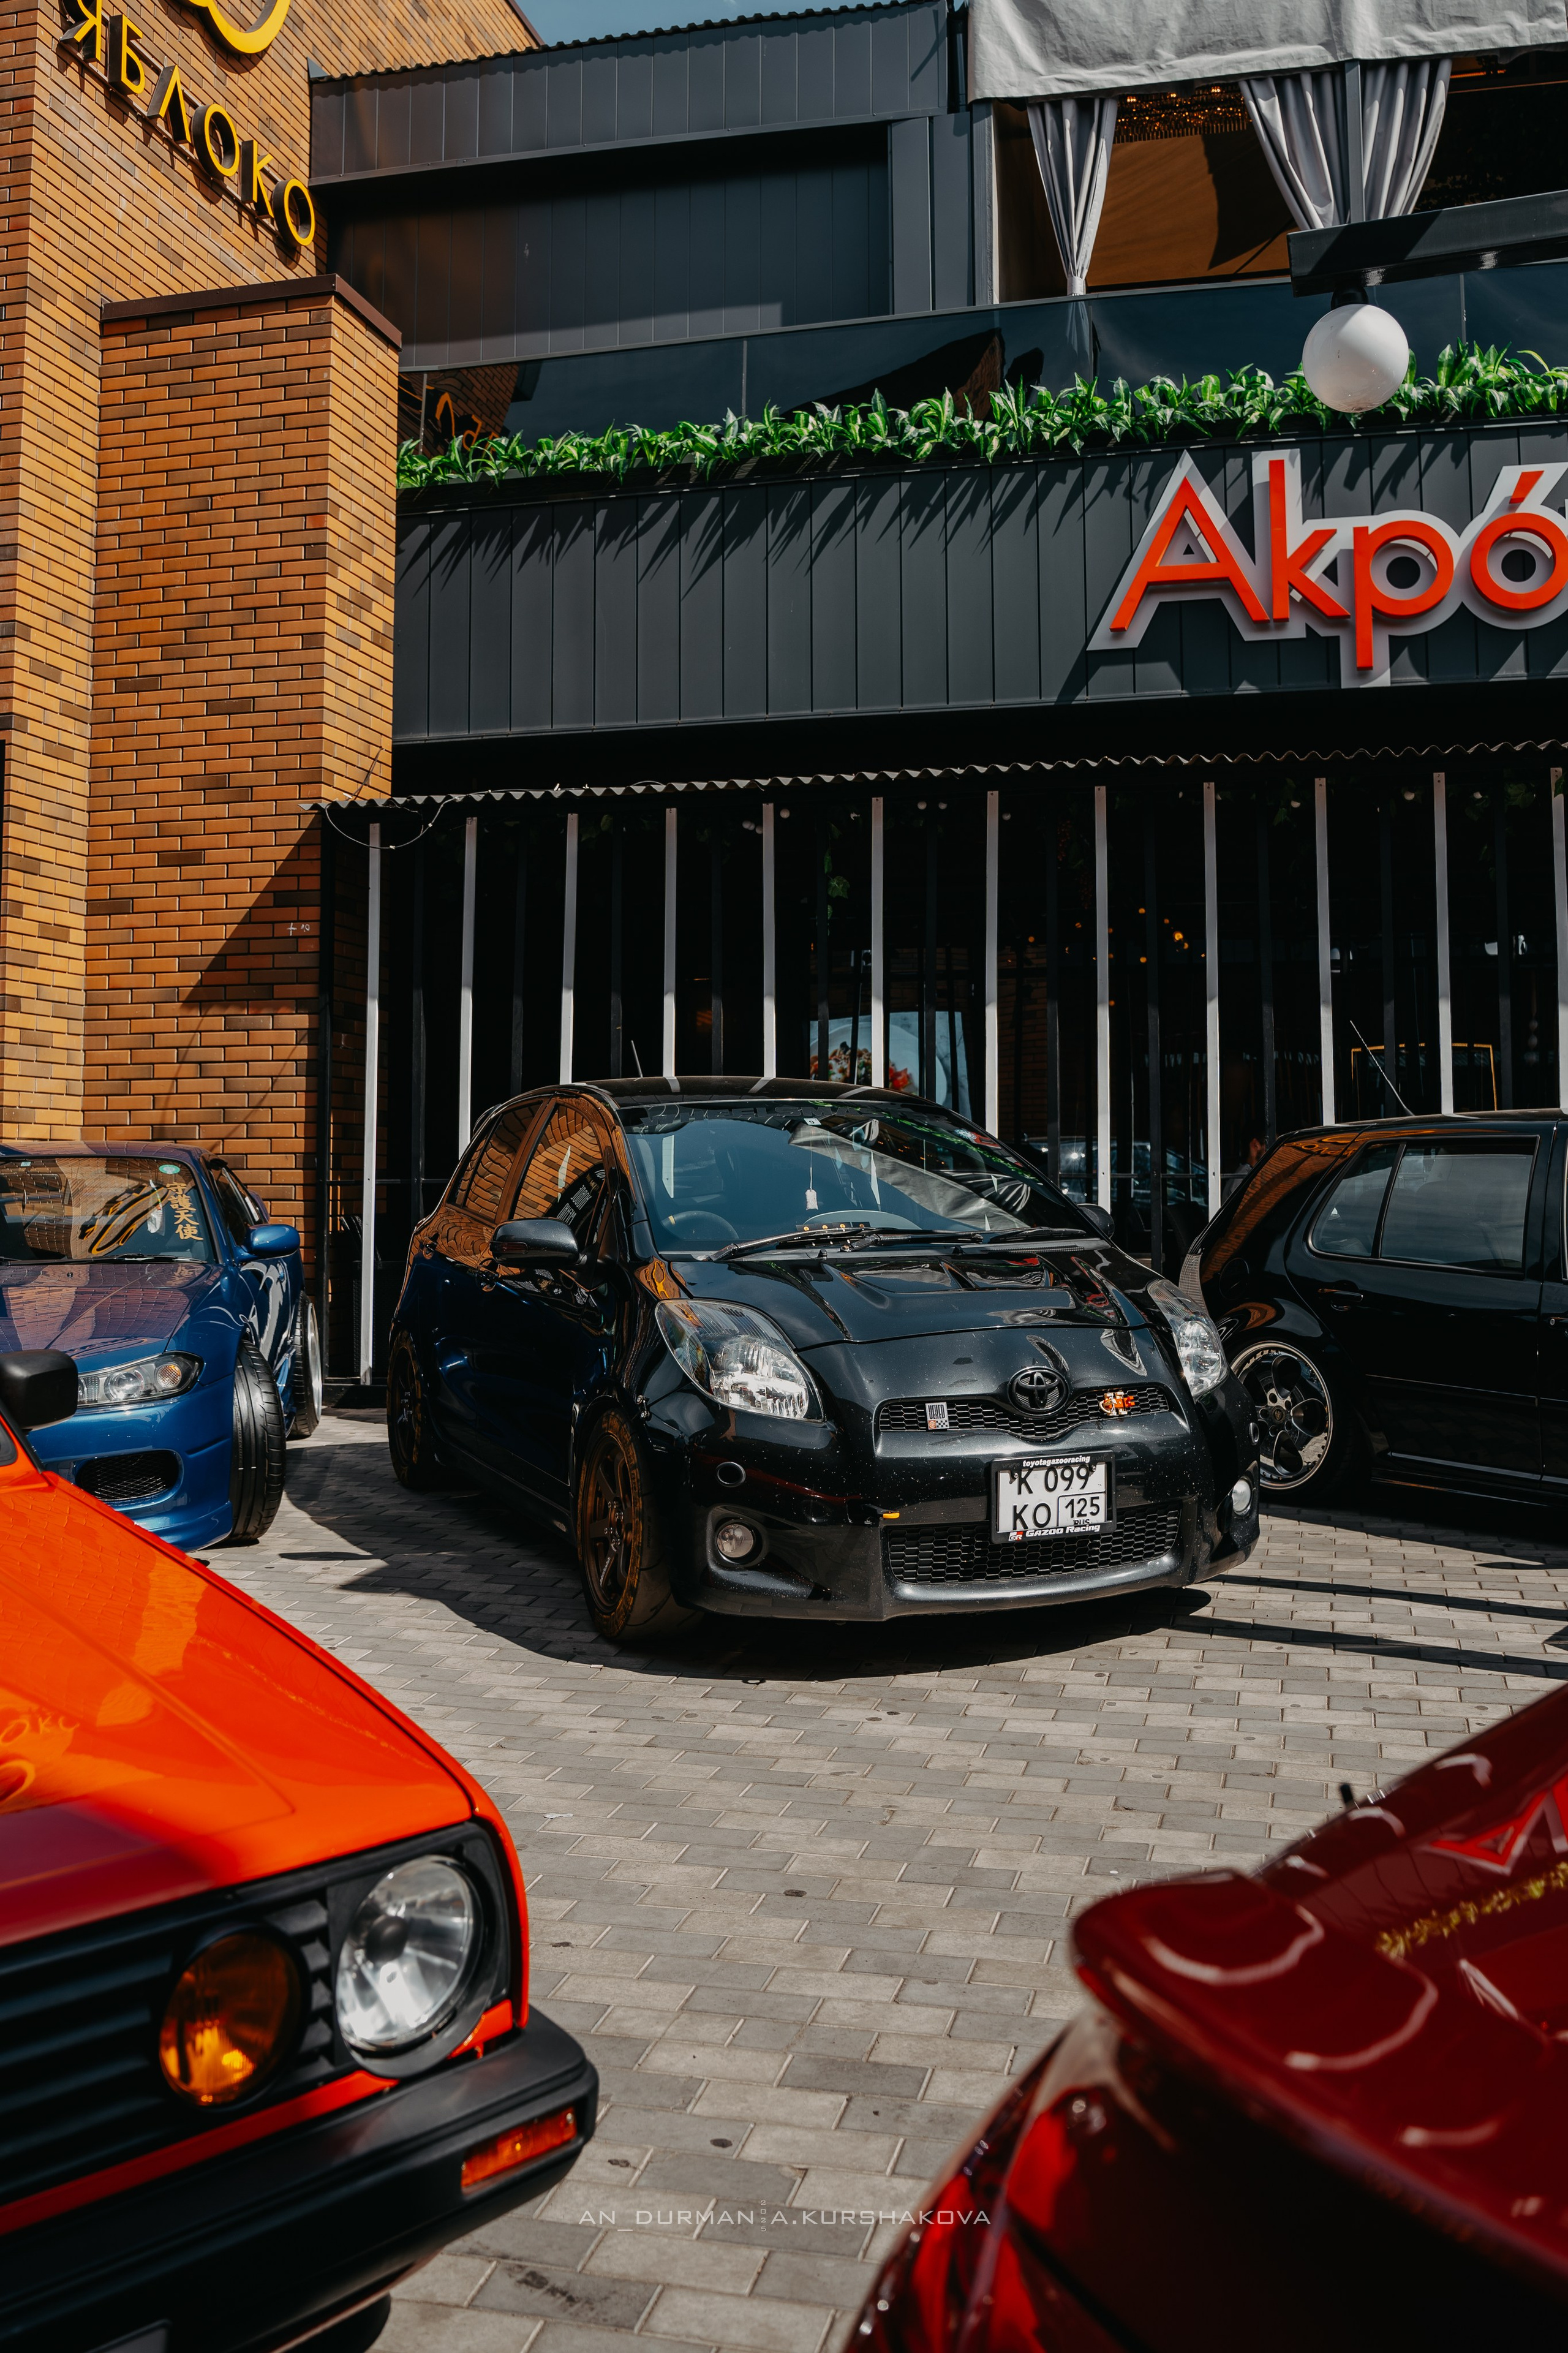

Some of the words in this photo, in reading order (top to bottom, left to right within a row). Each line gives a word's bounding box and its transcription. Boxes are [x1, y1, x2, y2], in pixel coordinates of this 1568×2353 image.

[62, 0, 316, 246] ЯБЛОКО
[165, 1181, 204, 1241] 守護天使
[1022, 1455, 1091, 1468] toyotagazooracing
[1044, 1464, 1090, 1492] 099
[1065, 1496, 1101, 1519] 125
[1065, 1524, 1101, 1533] Racing
